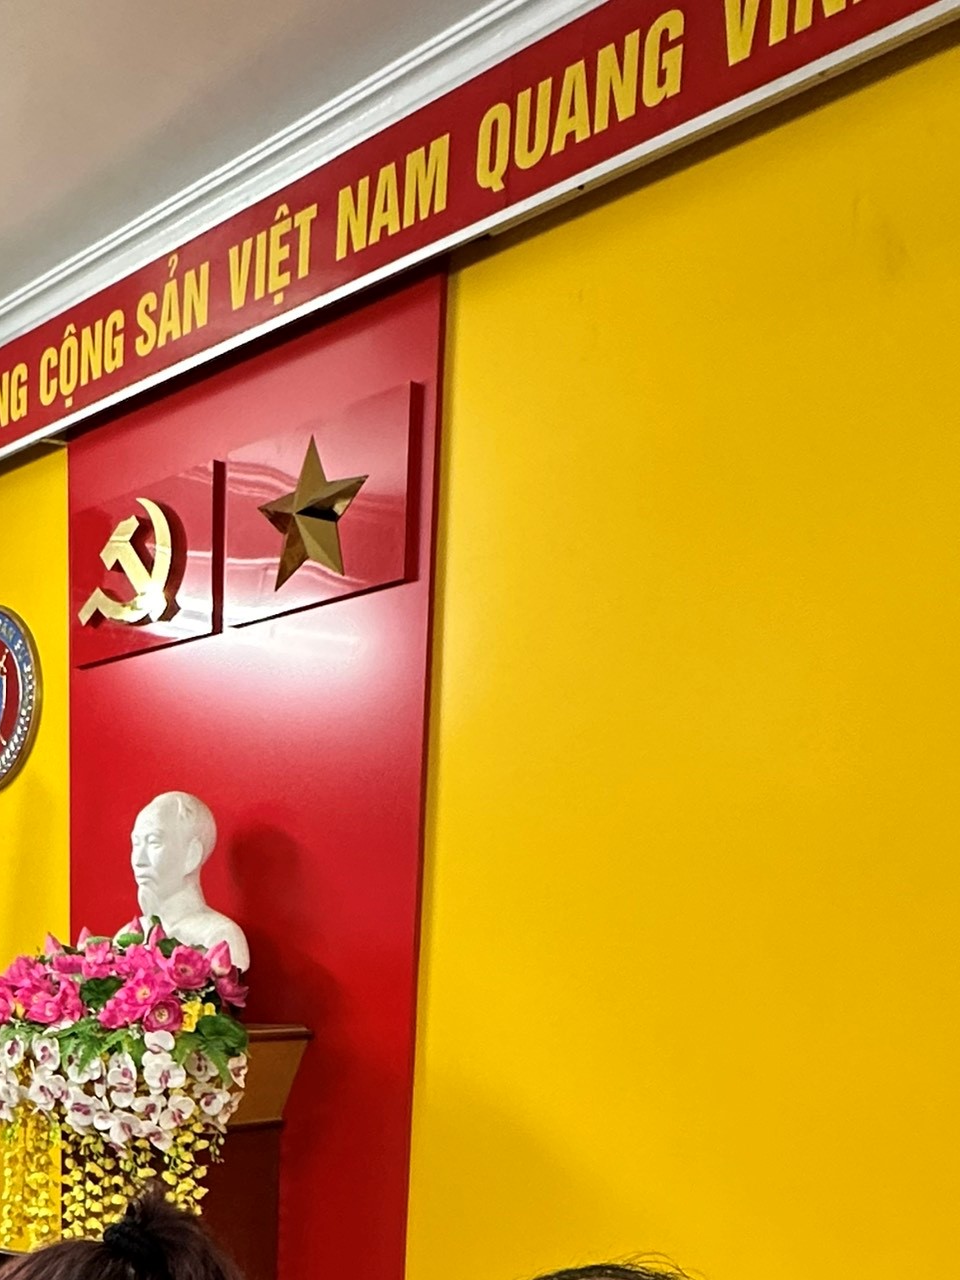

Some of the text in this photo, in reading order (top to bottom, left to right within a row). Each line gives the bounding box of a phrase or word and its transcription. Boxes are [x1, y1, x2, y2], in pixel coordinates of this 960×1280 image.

[39, 309, 125, 411] CỘNG
[135, 253, 209, 350] SẢN
[228, 205, 317, 307] VIỆT
[335, 134, 450, 260] NAM
[474, 8, 684, 190] QUANG
